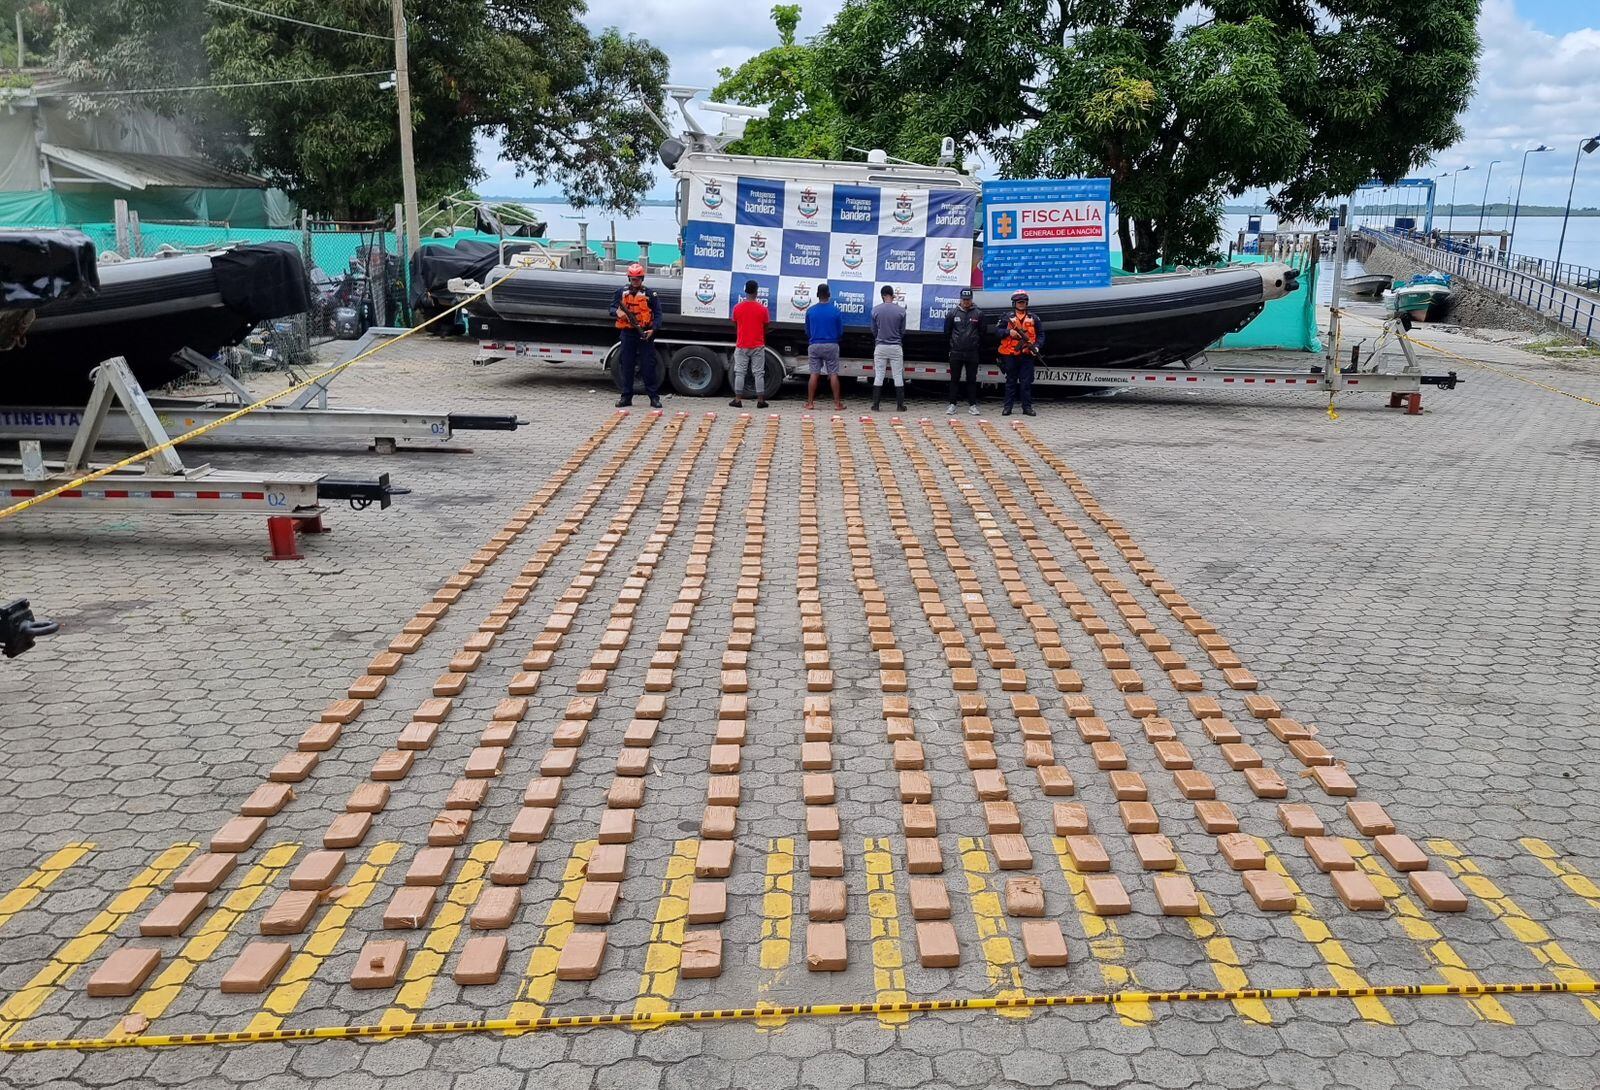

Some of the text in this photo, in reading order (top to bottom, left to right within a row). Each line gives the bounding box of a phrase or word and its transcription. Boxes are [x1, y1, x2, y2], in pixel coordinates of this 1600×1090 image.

[745, 201, 775, 215] bandera
[1021, 204, 1102, 223] FISCALÍA
[840, 210, 870, 221] bandera
[935, 214, 966, 226] bandera
[1023, 226, 1101, 237] GENERAL DE LA NACIÓN
[694, 244, 725, 258] bandera
[789, 253, 820, 267] bandera
[885, 260, 915, 271] bandera
[1035, 369, 1092, 383] TMASTER
[0, 411, 82, 427] TINENTA
[430, 423, 446, 435] 03
[267, 492, 287, 507] 02
